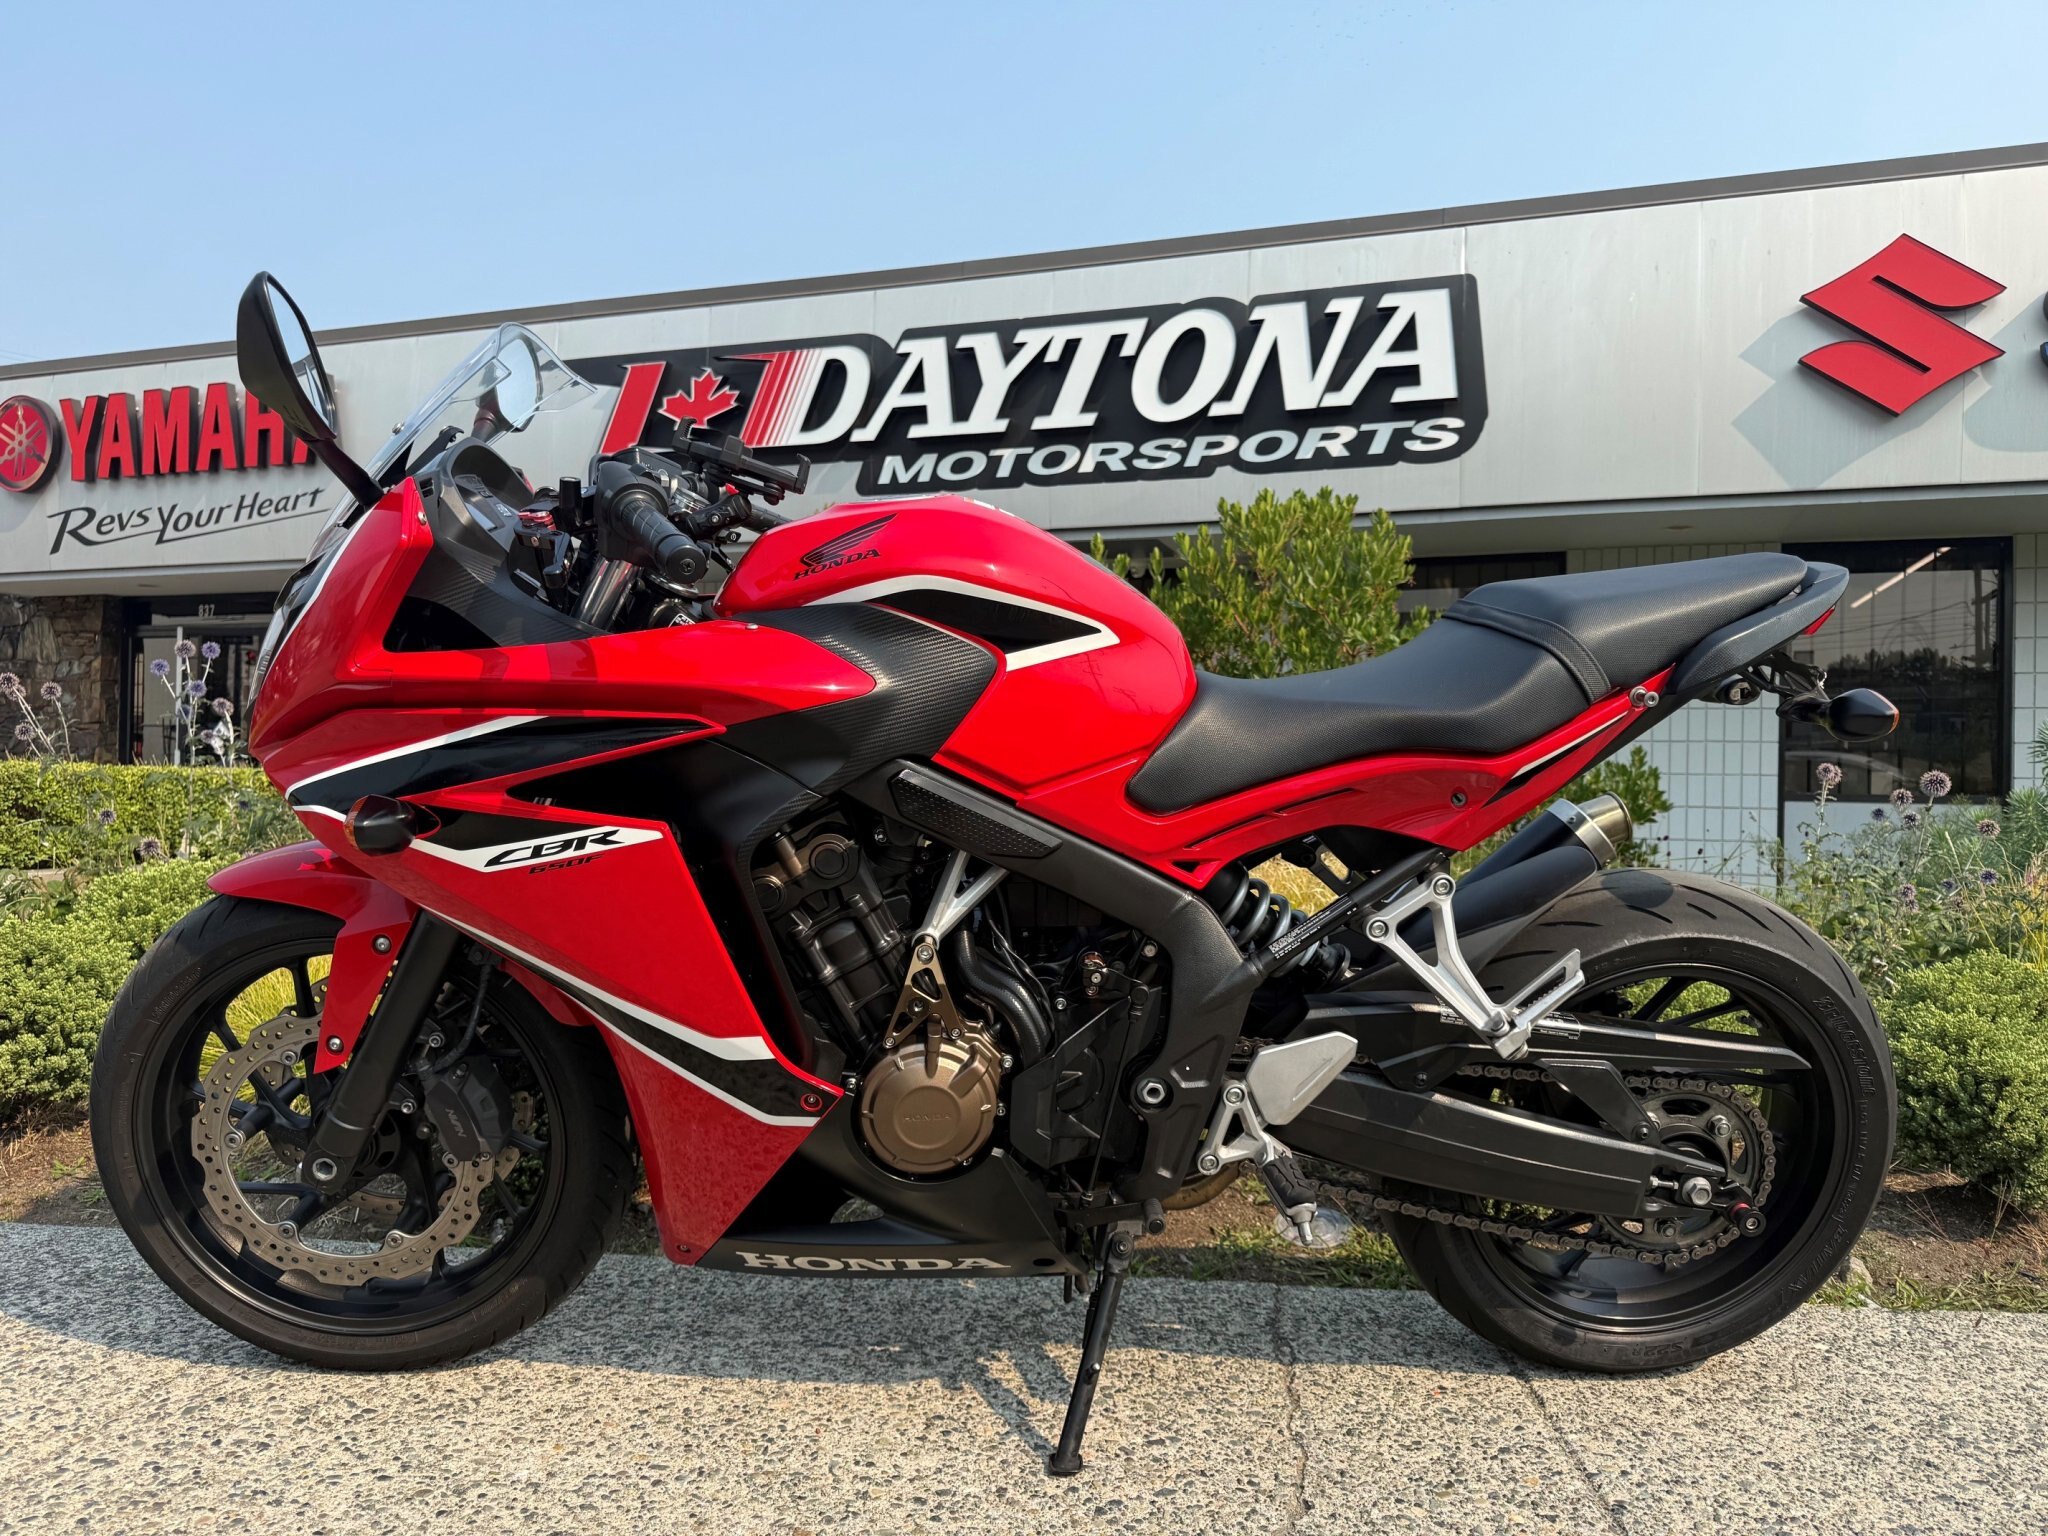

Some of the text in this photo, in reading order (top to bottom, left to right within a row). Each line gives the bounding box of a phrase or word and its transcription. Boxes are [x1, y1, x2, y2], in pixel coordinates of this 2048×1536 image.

[788, 287, 1459, 447] DAYTONA
[59, 381, 310, 482] YAMAH
[876, 416, 1466, 486] MOTORSPORTS
[47, 486, 326, 555] Revs Your Heart
[793, 548, 881, 580] HONDA
[484, 828, 626, 868] CBR
[528, 853, 605, 875] 650F
[735, 1251, 1012, 1272] HONDA
